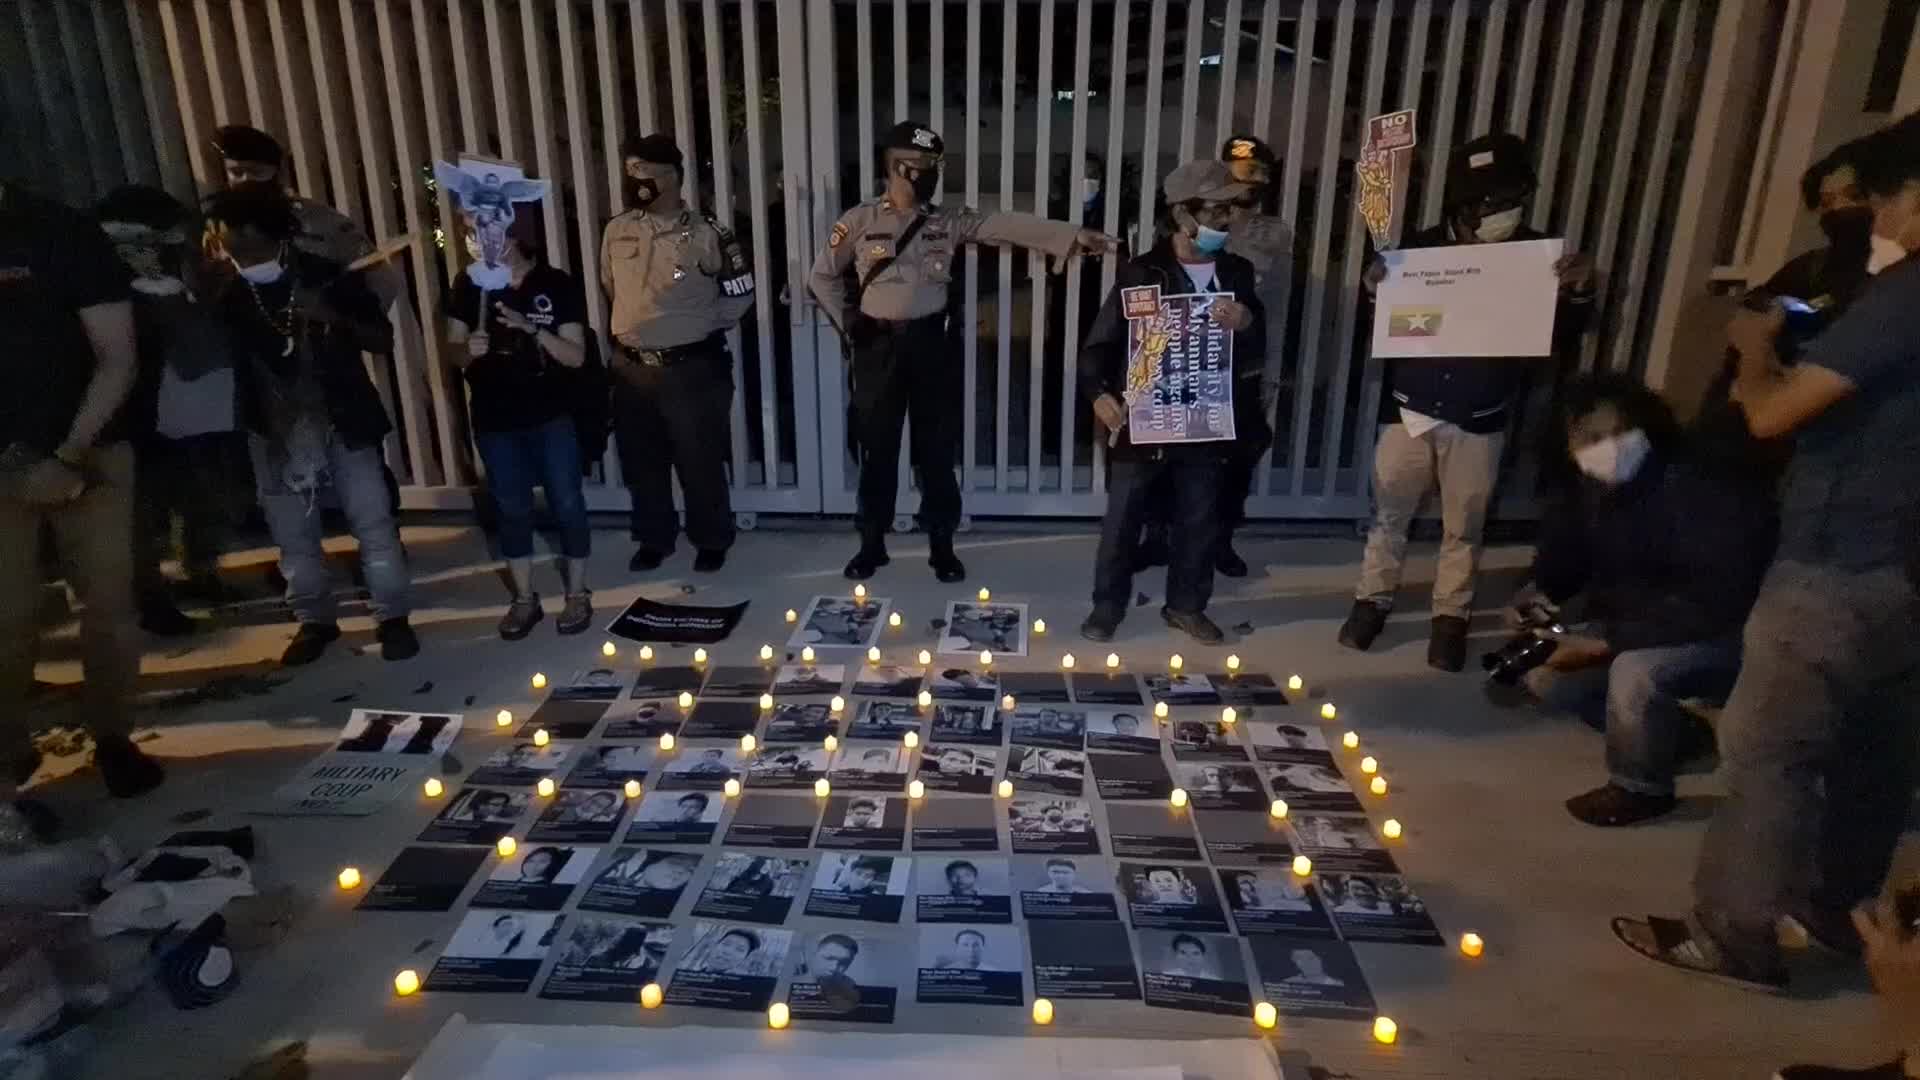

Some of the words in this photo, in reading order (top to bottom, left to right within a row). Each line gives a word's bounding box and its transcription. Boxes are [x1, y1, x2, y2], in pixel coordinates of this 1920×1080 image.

[1381, 114, 1407, 129] NO
[1168, 308, 1184, 368] people
[1206, 316, 1222, 395] olidarity
[1150, 389, 1164, 431] coup
[1168, 371, 1187, 438] against
[1208, 403, 1222, 431] for
[310, 782, 373, 799] COUP
[311, 765, 408, 783] MILITARY
